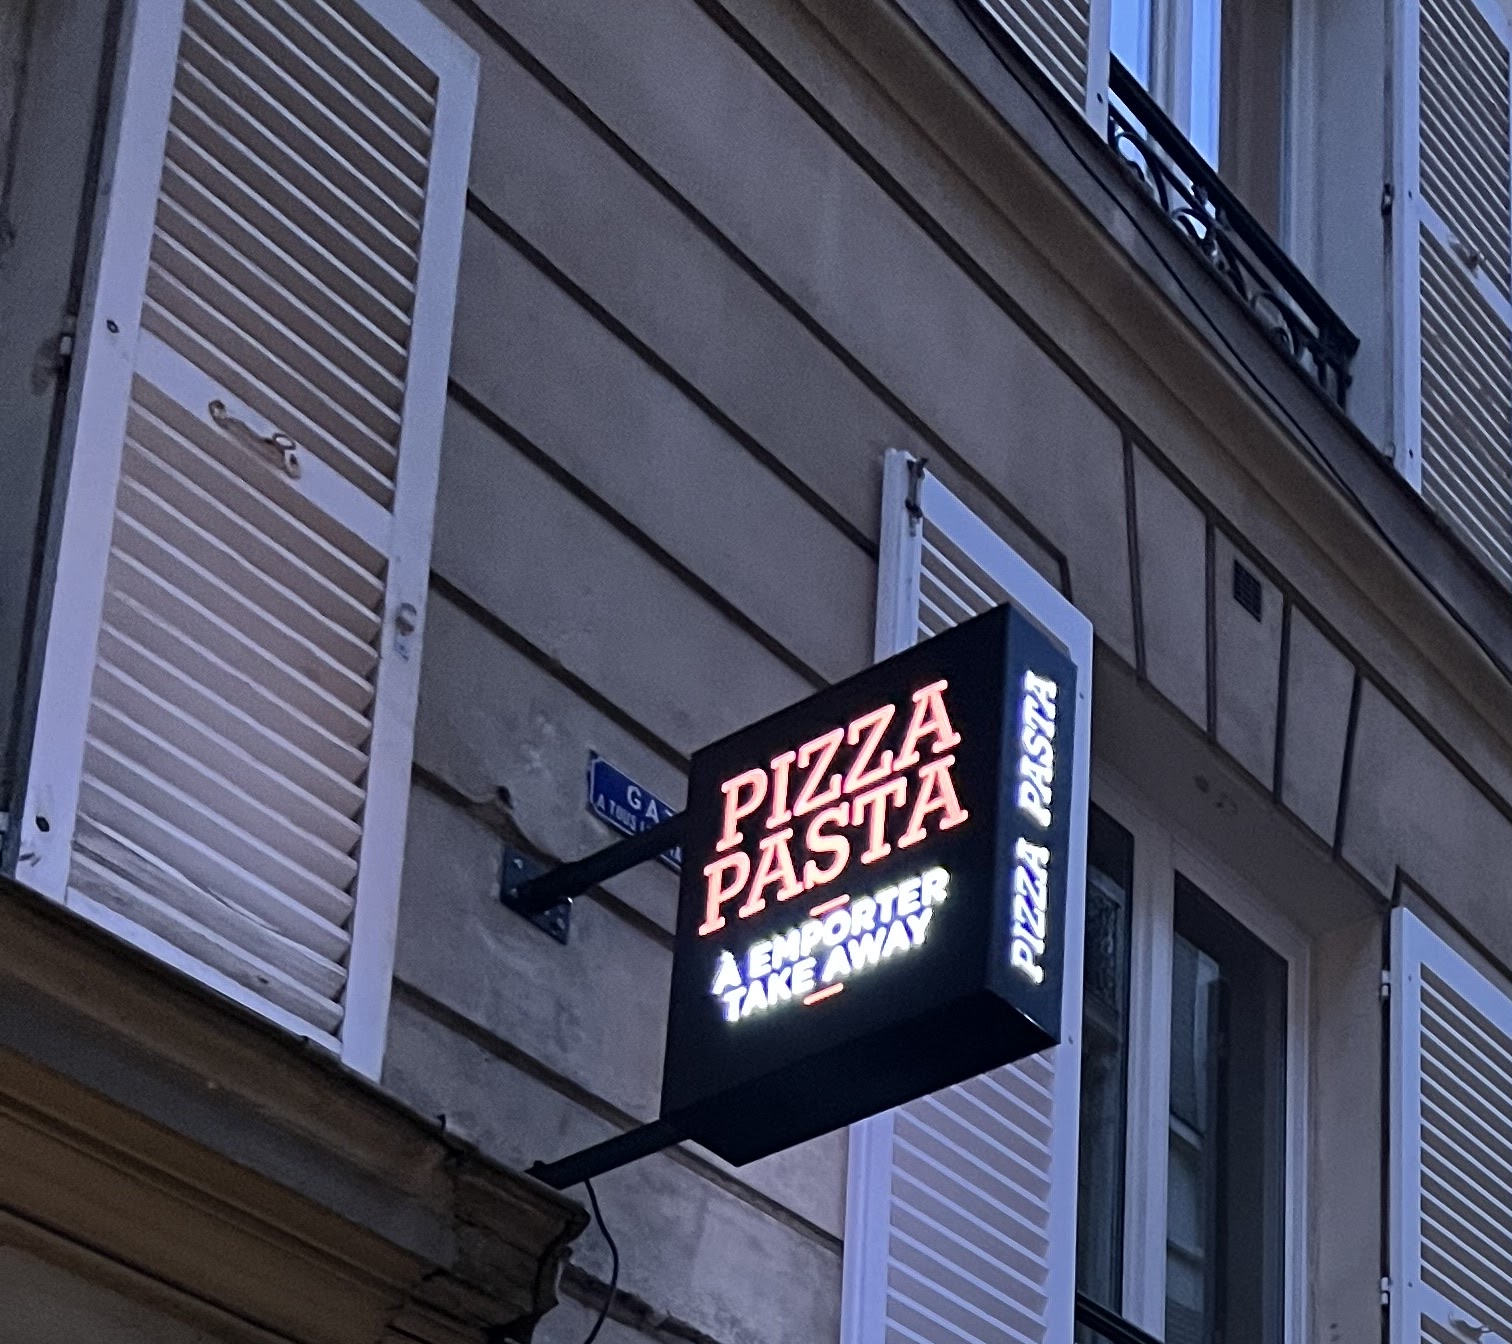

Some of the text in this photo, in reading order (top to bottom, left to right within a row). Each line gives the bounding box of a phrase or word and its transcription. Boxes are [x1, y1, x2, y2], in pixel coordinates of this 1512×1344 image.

[627, 785, 673, 824] GA
[716, 678, 961, 853] PIZZA
[1008, 669, 1058, 985] PIZZA PASTA
[698, 754, 968, 936] PASTA
[719, 906, 935, 1025] TAKE AWAY
[745, 865, 953, 983] EMPORTER
